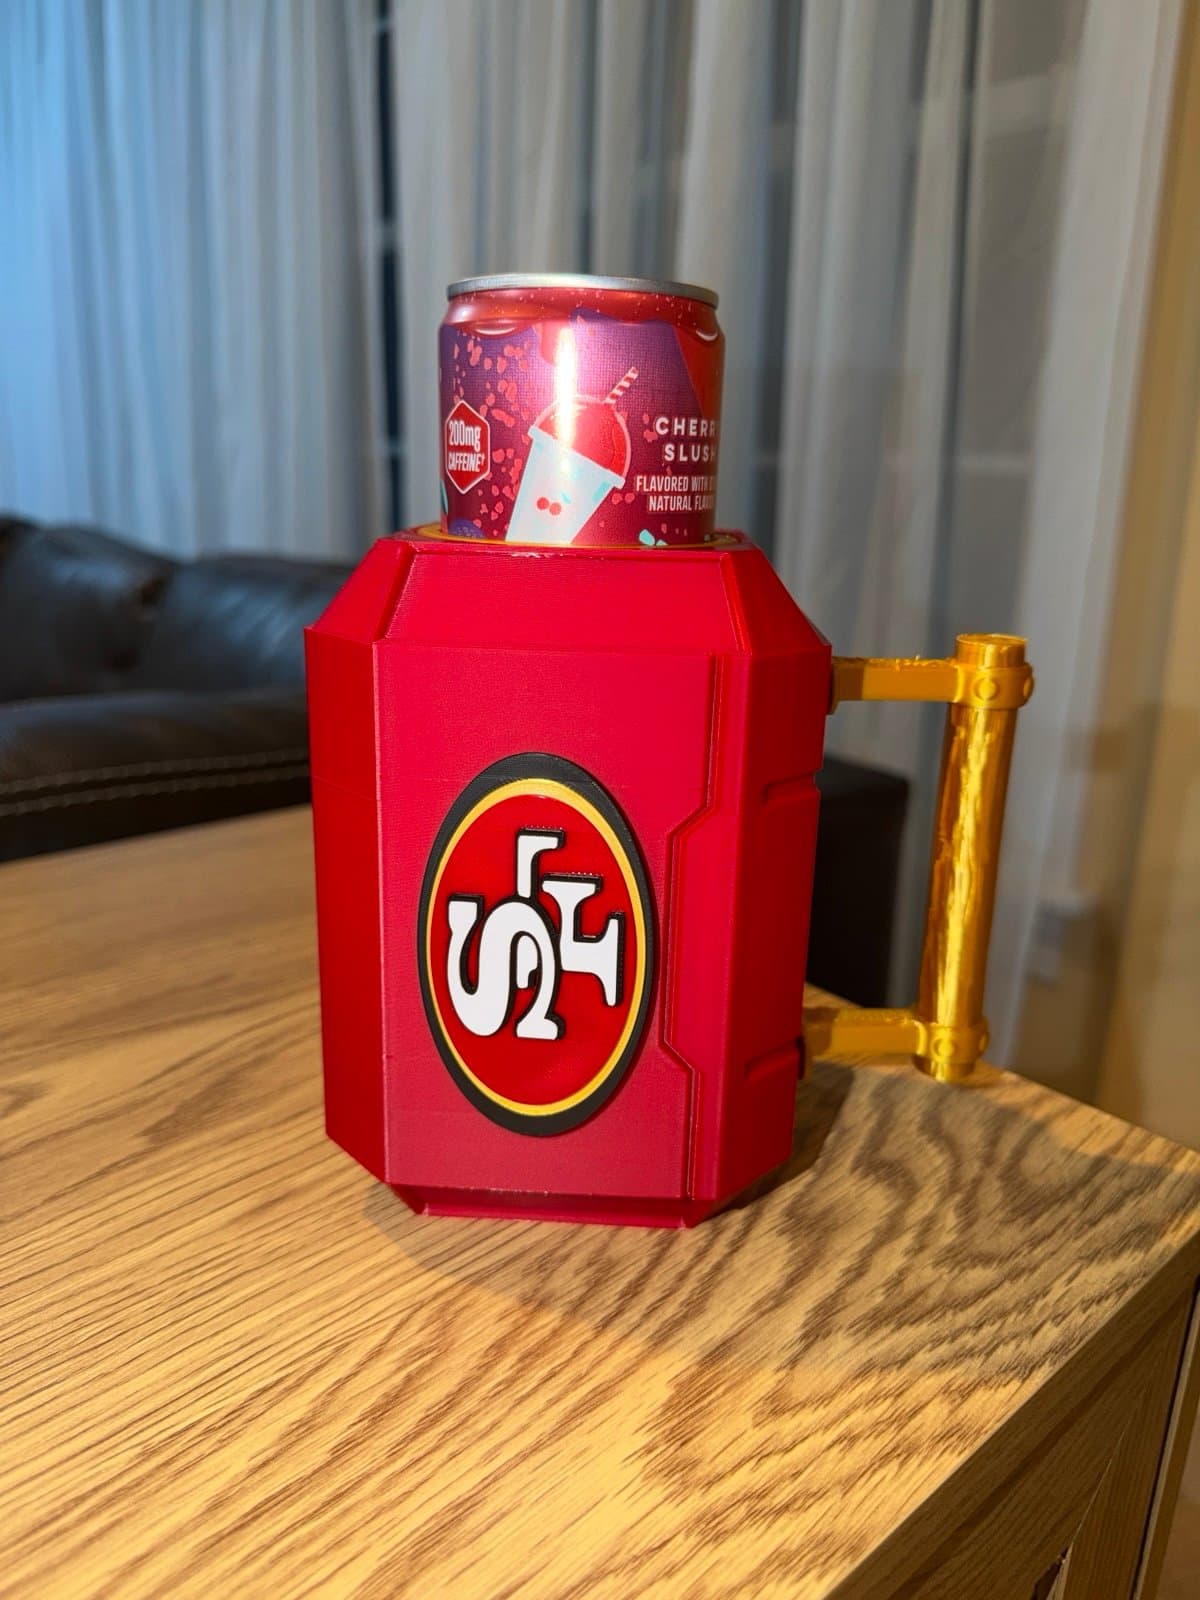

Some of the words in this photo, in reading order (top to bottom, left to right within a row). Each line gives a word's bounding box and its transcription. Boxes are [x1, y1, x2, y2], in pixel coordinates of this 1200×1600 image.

[448, 419, 481, 452] 200mg
[655, 416, 719, 437] CHERR
[636, 475, 689, 492] FLAVORED
[649, 495, 692, 511] NATURAL
